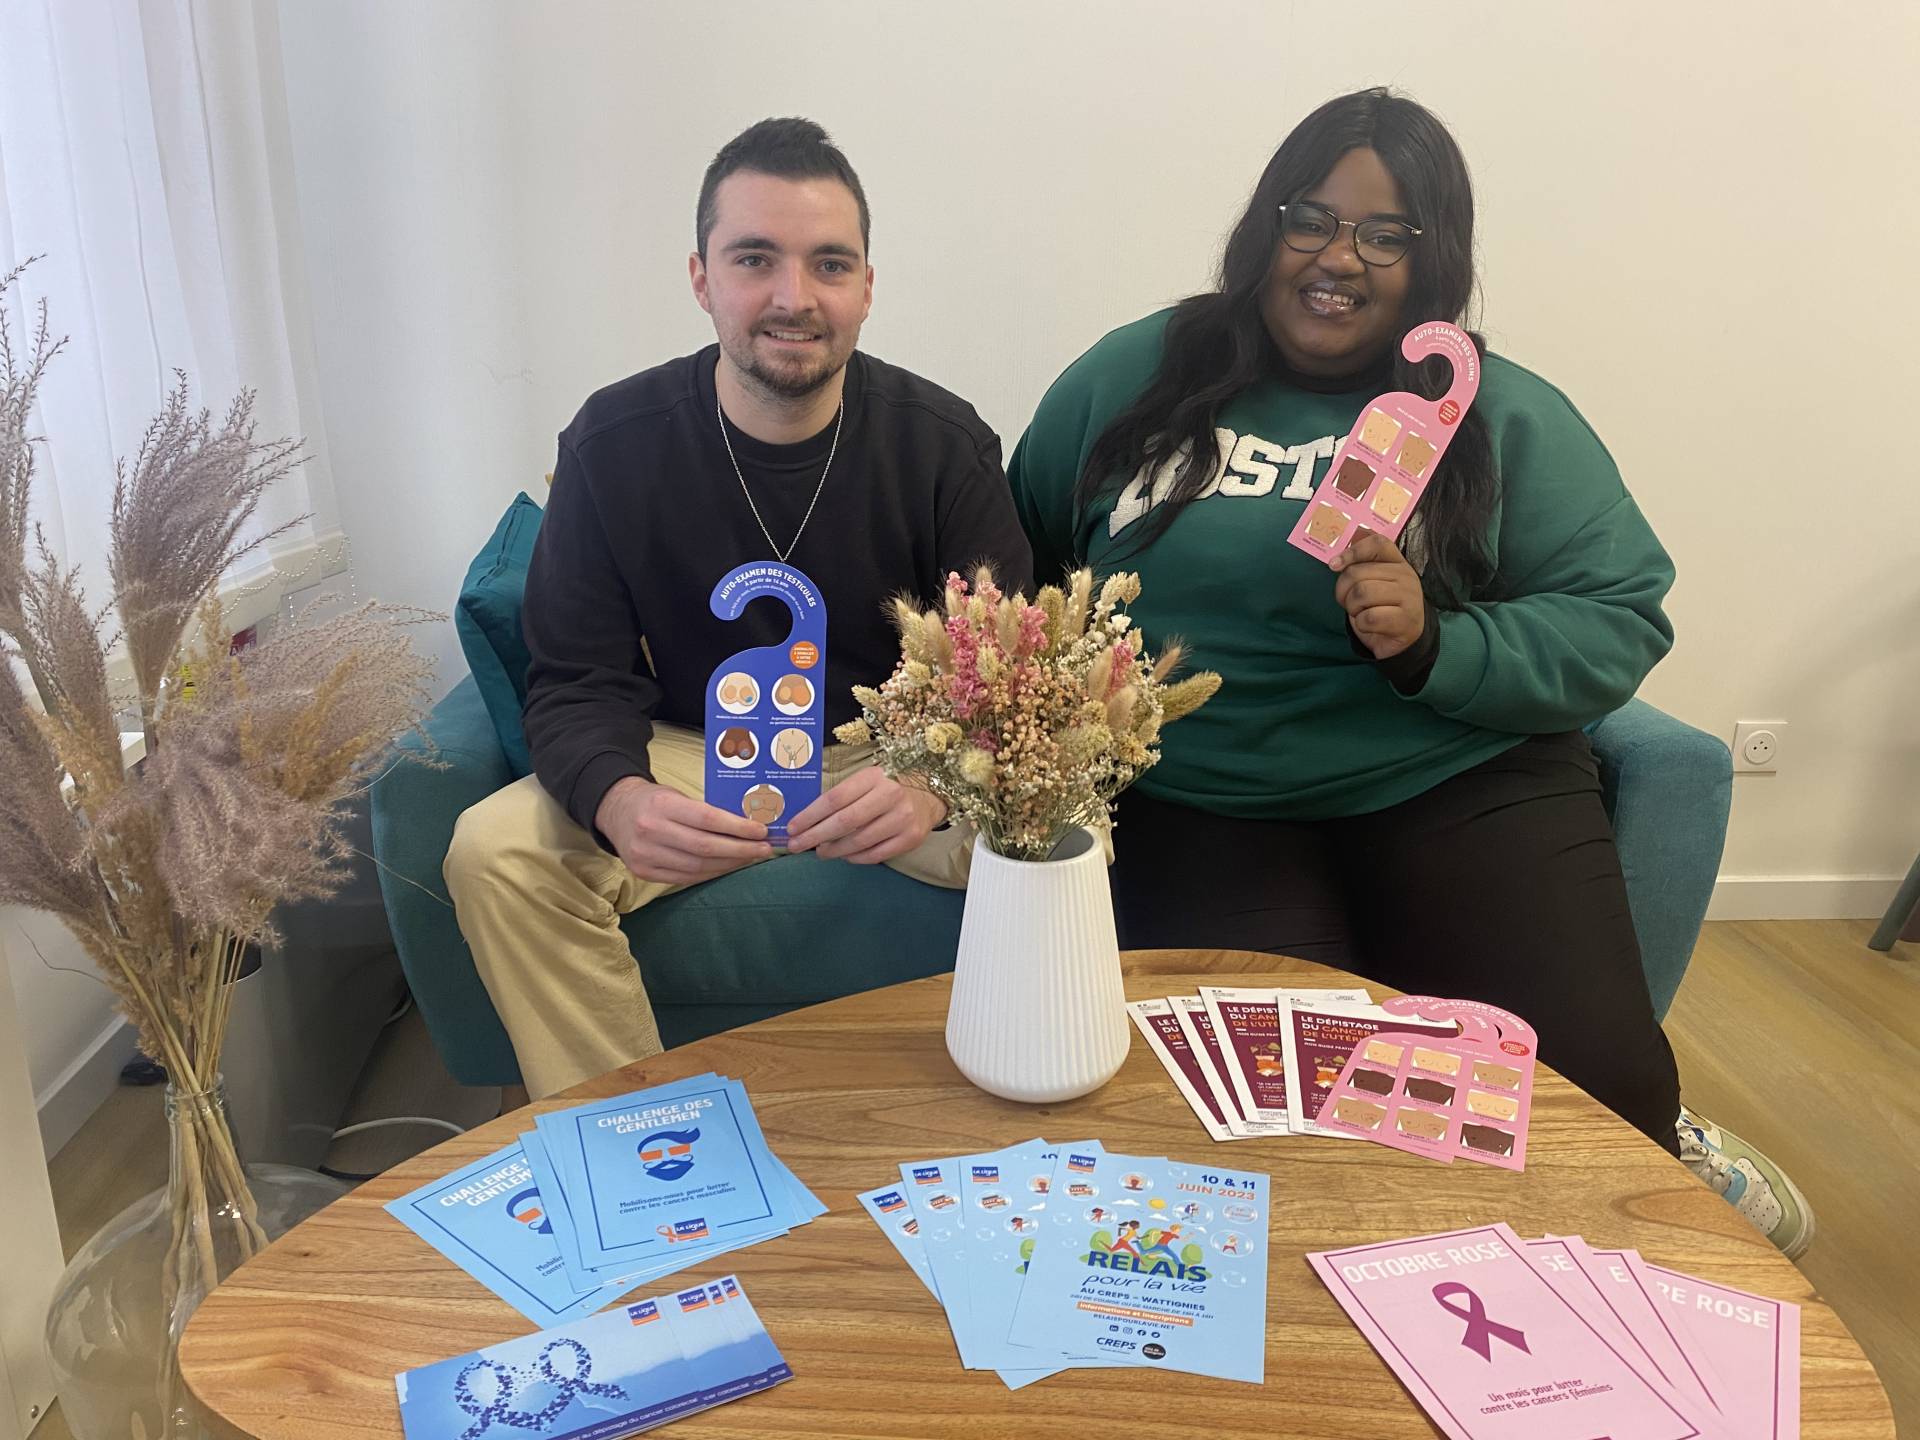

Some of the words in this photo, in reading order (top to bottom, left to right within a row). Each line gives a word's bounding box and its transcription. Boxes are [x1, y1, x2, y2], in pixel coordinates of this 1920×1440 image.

[1413, 326, 1464, 344] AUTO-EXAMEN
[1461, 341, 1472, 357] DES
[1467, 357, 1475, 382] SEINS
[720, 568, 767, 600] AUTO-EXAMEN
[768, 568, 783, 578] DES
[783, 572, 817, 608] TESTICULES
[1241, 1006, 1278, 1014] DÉPIST
[1249, 1013, 1278, 1021] CAN
[1157, 1018, 1173, 1026] LE
[1163, 1026, 1179, 1034] DU
[1250, 1020, 1279, 1028] L'UTÉ
[1300, 1015, 1314, 1023] LE
[1316, 1017, 1380, 1031] DÉPISTAGE
[1302, 1022, 1319, 1031] DU
[1321, 1025, 1372, 1037] CANCER
[1302, 1030, 1318, 1038] DE
[1321, 1032, 1362, 1043] L'UTÉR
[598, 1105, 681, 1128] CHALLENGE
[684, 1099, 713, 1111] DES
[616, 1110, 701, 1134] GENTLEMEN
[439, 1162, 521, 1208] CHALLENGE
[465, 1167, 534, 1208] GENTLEM
[1175, 1181, 1213, 1195] JUIN
[1218, 1188, 1256, 1201] 2023
[1201, 1174, 1219, 1185] 10
[1224, 1178, 1236, 1187] &
[1242, 1180, 1256, 1190] 11
[620, 1192, 684, 1208] Mobilisons-nous
[686, 1187, 705, 1197] pour
[706, 1182, 730, 1191] lutter
[620, 1204, 646, 1215] contre
[648, 1201, 661, 1209] les
[663, 1195, 695, 1206] cancers
[696, 1186, 737, 1201] masculins
[1087, 1250, 1207, 1283] RELAIS
[1342, 1252, 1449, 1284] OCTOBRE
[1445, 1242, 1510, 1267] ROSE
[1081, 1274, 1140, 1287] pour
[1143, 1277, 1163, 1290] la
[1171, 1281, 1207, 1294] vie
[1080, 1286, 1096, 1295] AU
[1097, 1289, 1130, 1300] CREPS
[1141, 1295, 1206, 1311] WATTIGNIES
[1093, 1313, 1176, 1331] RELAISPOURLAVIE.NET
[1696, 1294, 1770, 1330] ROSE
[1096, 1337, 1137, 1350] CREPS
[1480, 1402, 1514, 1415] contre
[1512, 1399, 1530, 1410] les
[1531, 1391, 1569, 1406] cancers
[1568, 1384, 1614, 1401] féminins
[1487, 1392, 1505, 1403] Un
[1505, 1387, 1530, 1400] mois
[1531, 1384, 1554, 1399] pour
[1553, 1378, 1583, 1391] lutter
[629, 1416, 639, 1424] du
[640, 1409, 663, 1421] cancer
